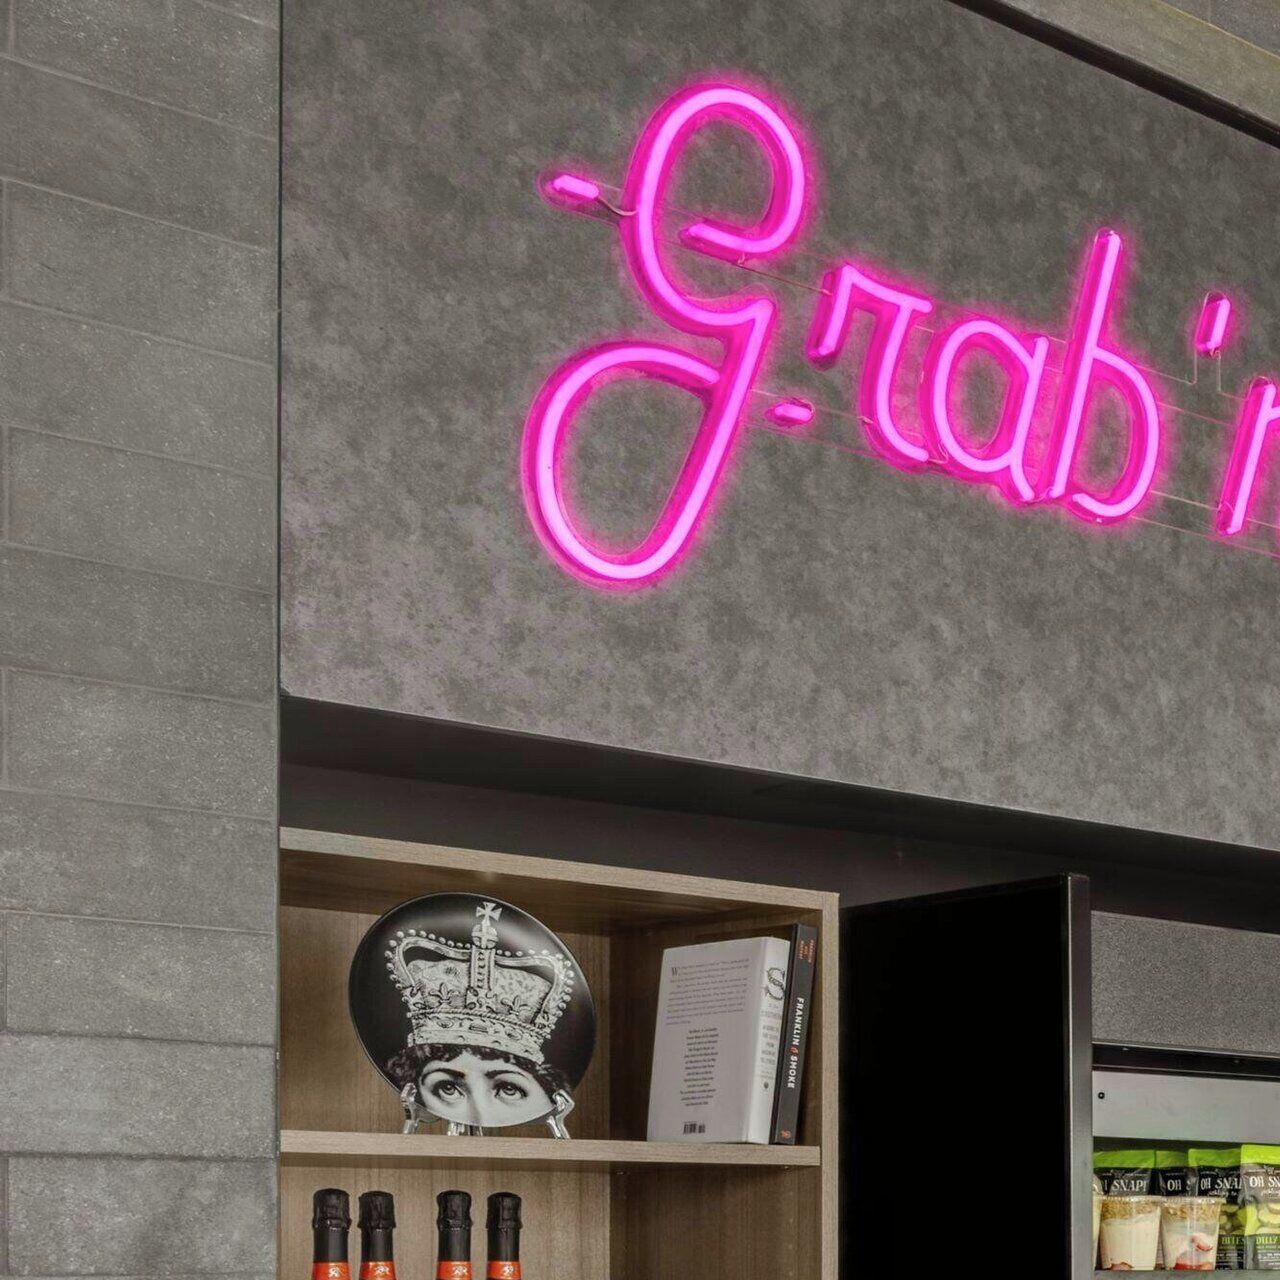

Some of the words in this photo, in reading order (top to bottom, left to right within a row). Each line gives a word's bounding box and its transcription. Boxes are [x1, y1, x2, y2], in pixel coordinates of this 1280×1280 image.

[523, 84, 1162, 586] Grab
[792, 997, 804, 1046] FRANKLIN
[787, 1055, 799, 1089] SMOKE
[1167, 1179, 1182, 1191] OH
[1201, 1178, 1211, 1189] OH
[1249, 1176, 1266, 1188] OH
